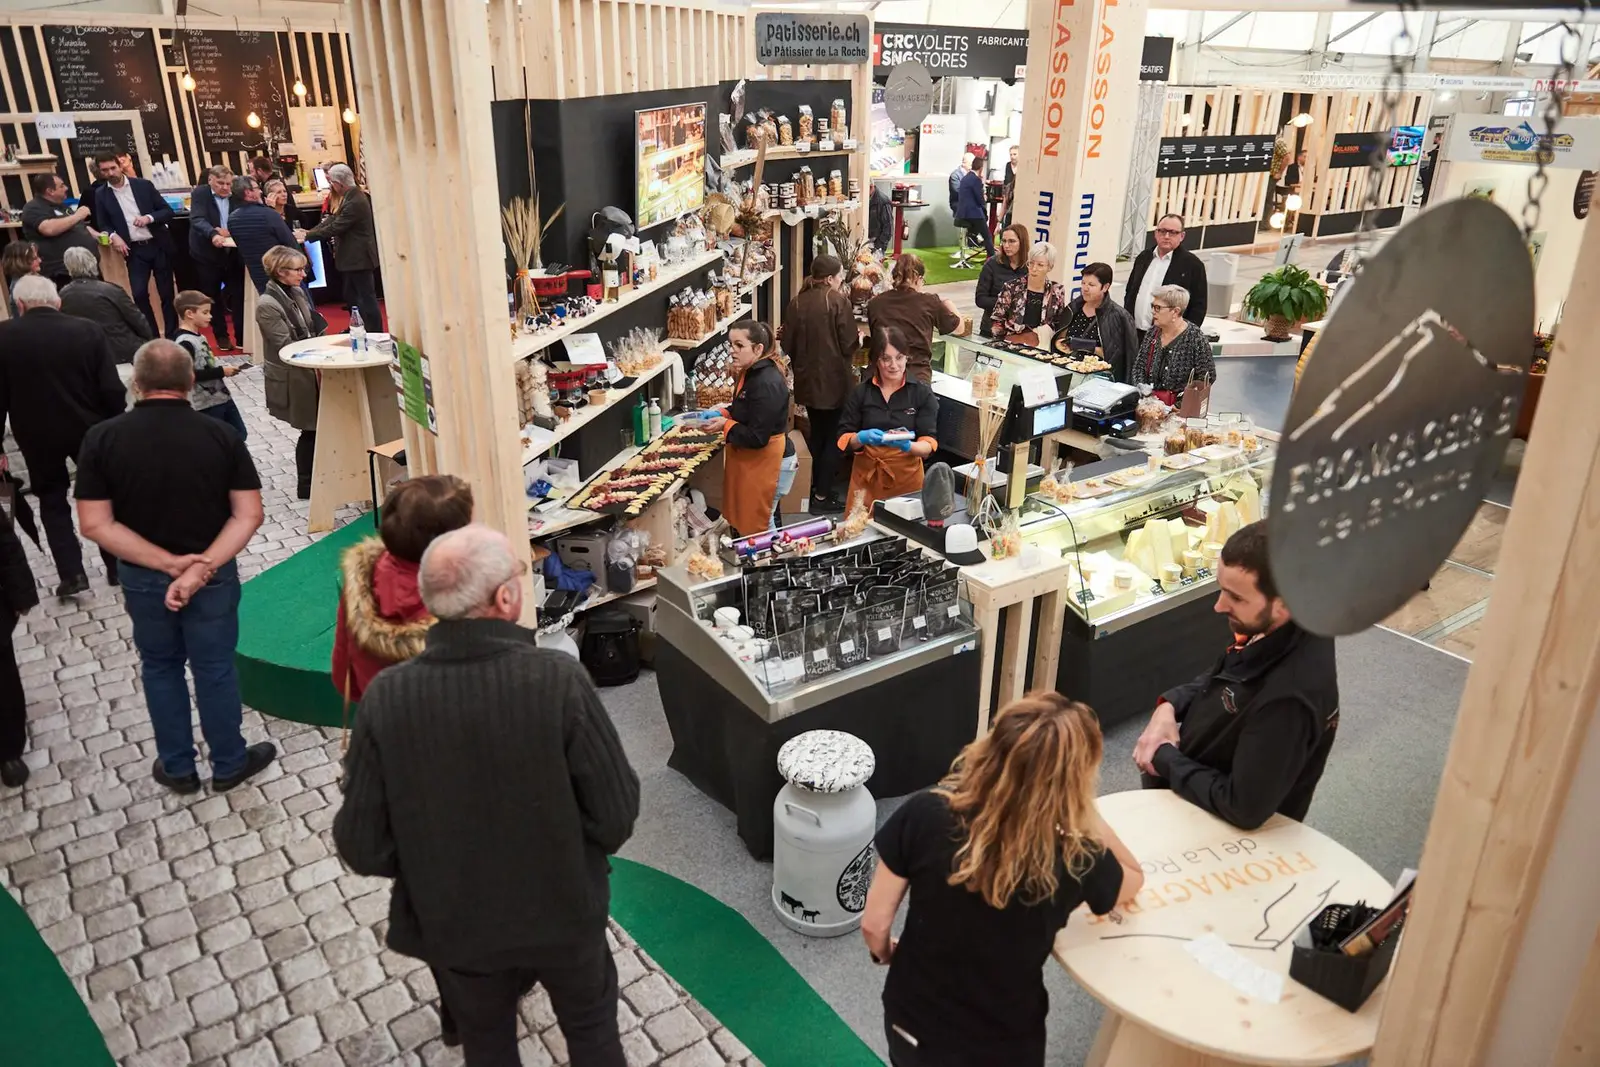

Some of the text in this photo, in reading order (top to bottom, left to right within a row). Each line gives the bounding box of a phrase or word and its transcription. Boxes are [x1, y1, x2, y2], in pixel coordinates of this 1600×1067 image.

[767, 21, 860, 43] patisserie.ch
[977, 36, 1025, 47] FABRICANT
[760, 45, 866, 57] Le Pâtissier de La Roche
[1044, 0, 1075, 157] LASSON
[1087, 0, 1119, 159] LASSON
[1140, 65, 1164, 74] REATIFS
[1035, 191, 1053, 244] MIA
[1140, 837, 1258, 875] de La Ro
